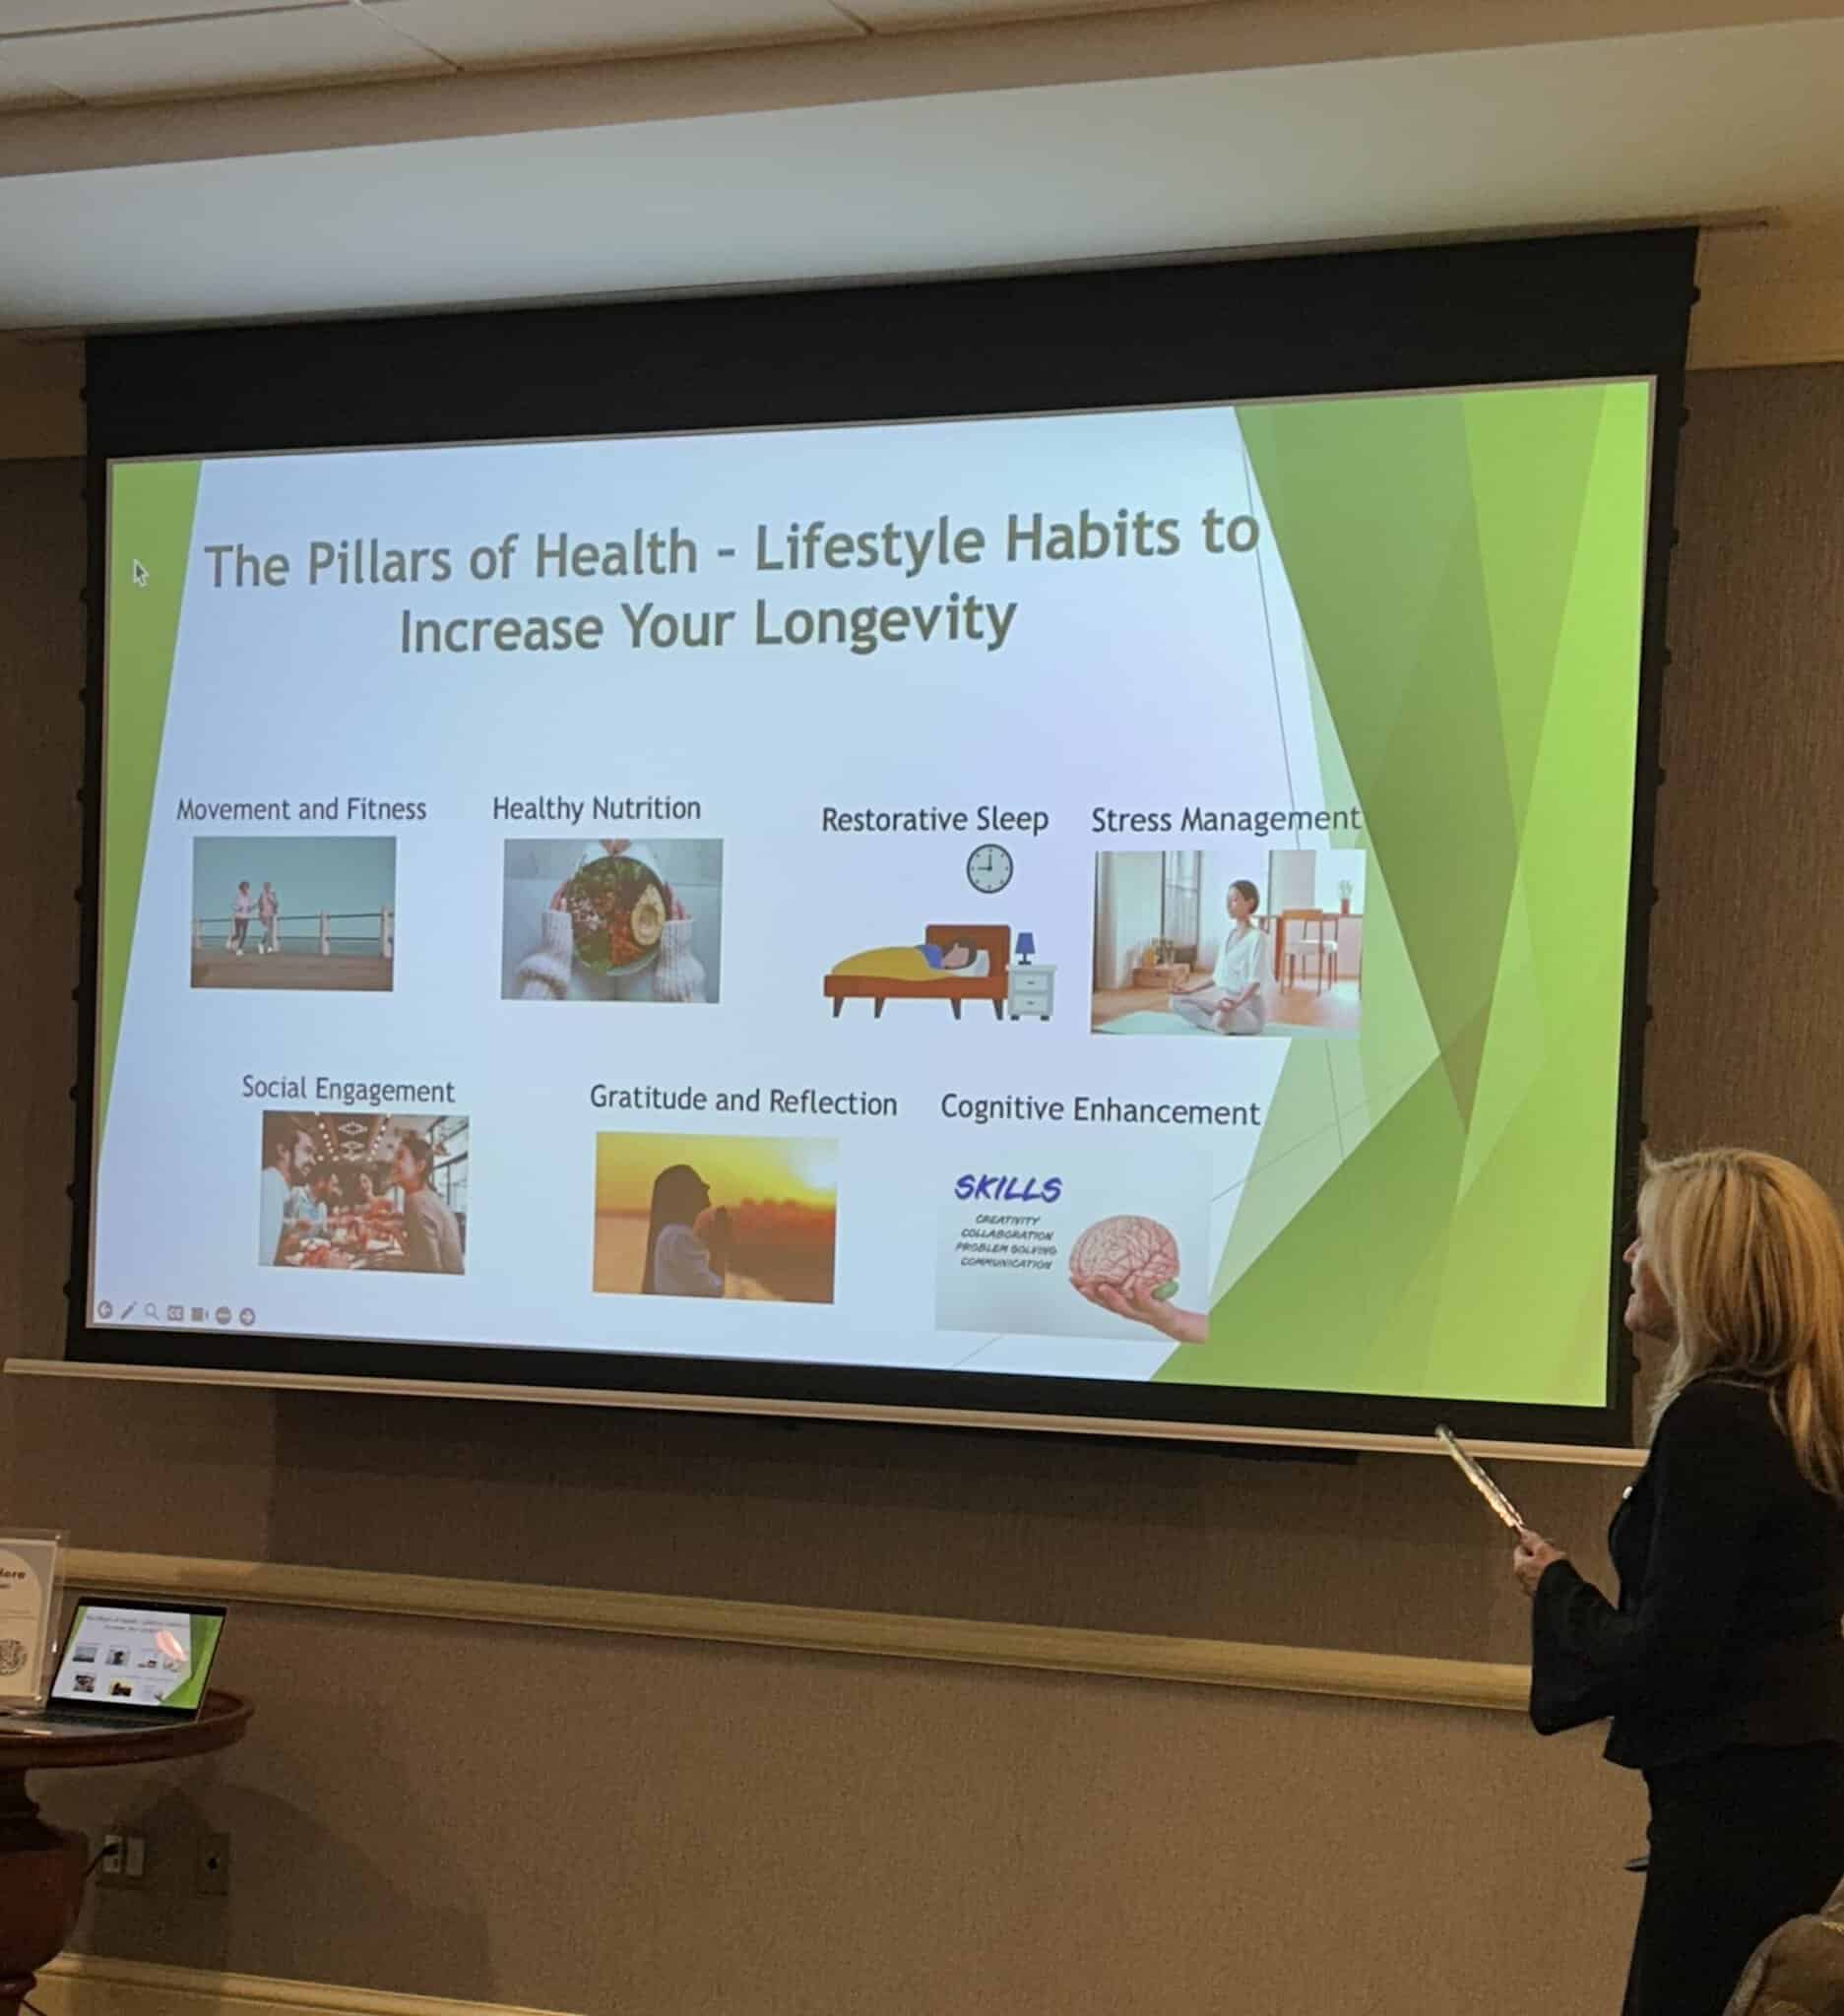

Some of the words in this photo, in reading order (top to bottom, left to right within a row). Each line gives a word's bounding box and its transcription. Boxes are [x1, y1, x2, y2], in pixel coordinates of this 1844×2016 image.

[204, 542, 289, 589] The
[308, 538, 452, 585] Pillars
[470, 534, 519, 580] of
[536, 527, 698, 579] Health
[756, 515, 984, 579] Lifestyle
[1006, 508, 1179, 562] Habits
[1202, 508, 1259, 553] to
[401, 609, 604, 653] Increase
[620, 602, 735, 649] Your
[755, 593, 1018, 655] Longevity
[176, 798, 291, 820] Movement
[298, 798, 338, 820] and
[348, 797, 427, 820] Fitness
[493, 796, 584, 825] Healthy
[593, 795, 702, 820] Nutrition
[822, 807, 969, 832] Restorative
[977, 807, 1049, 837] Sleep
[1091, 809, 1172, 832] Stress
[1180, 807, 1363, 837] Management
[242, 1074, 307, 1099] Social
[316, 1077, 456, 1106] Engagement
[591, 1084, 708, 1110] Gratitude
[716, 1089, 760, 1111] and
[770, 1089, 898, 1116] Reflection
[941, 1094, 1064, 1124] Cognitive
[1074, 1098, 1261, 1125] Enhancement
[954, 1174, 1063, 1203] SKILLS
[961, 1228, 1054, 1241] COLLABORATION
[976, 1214, 1041, 1227] CREATIVITY
[955, 1242, 1009, 1253] PROBLEM
[1011, 1244, 1057, 1255] SOLVING
[960, 1257, 1052, 1270] COMMUNICATION
